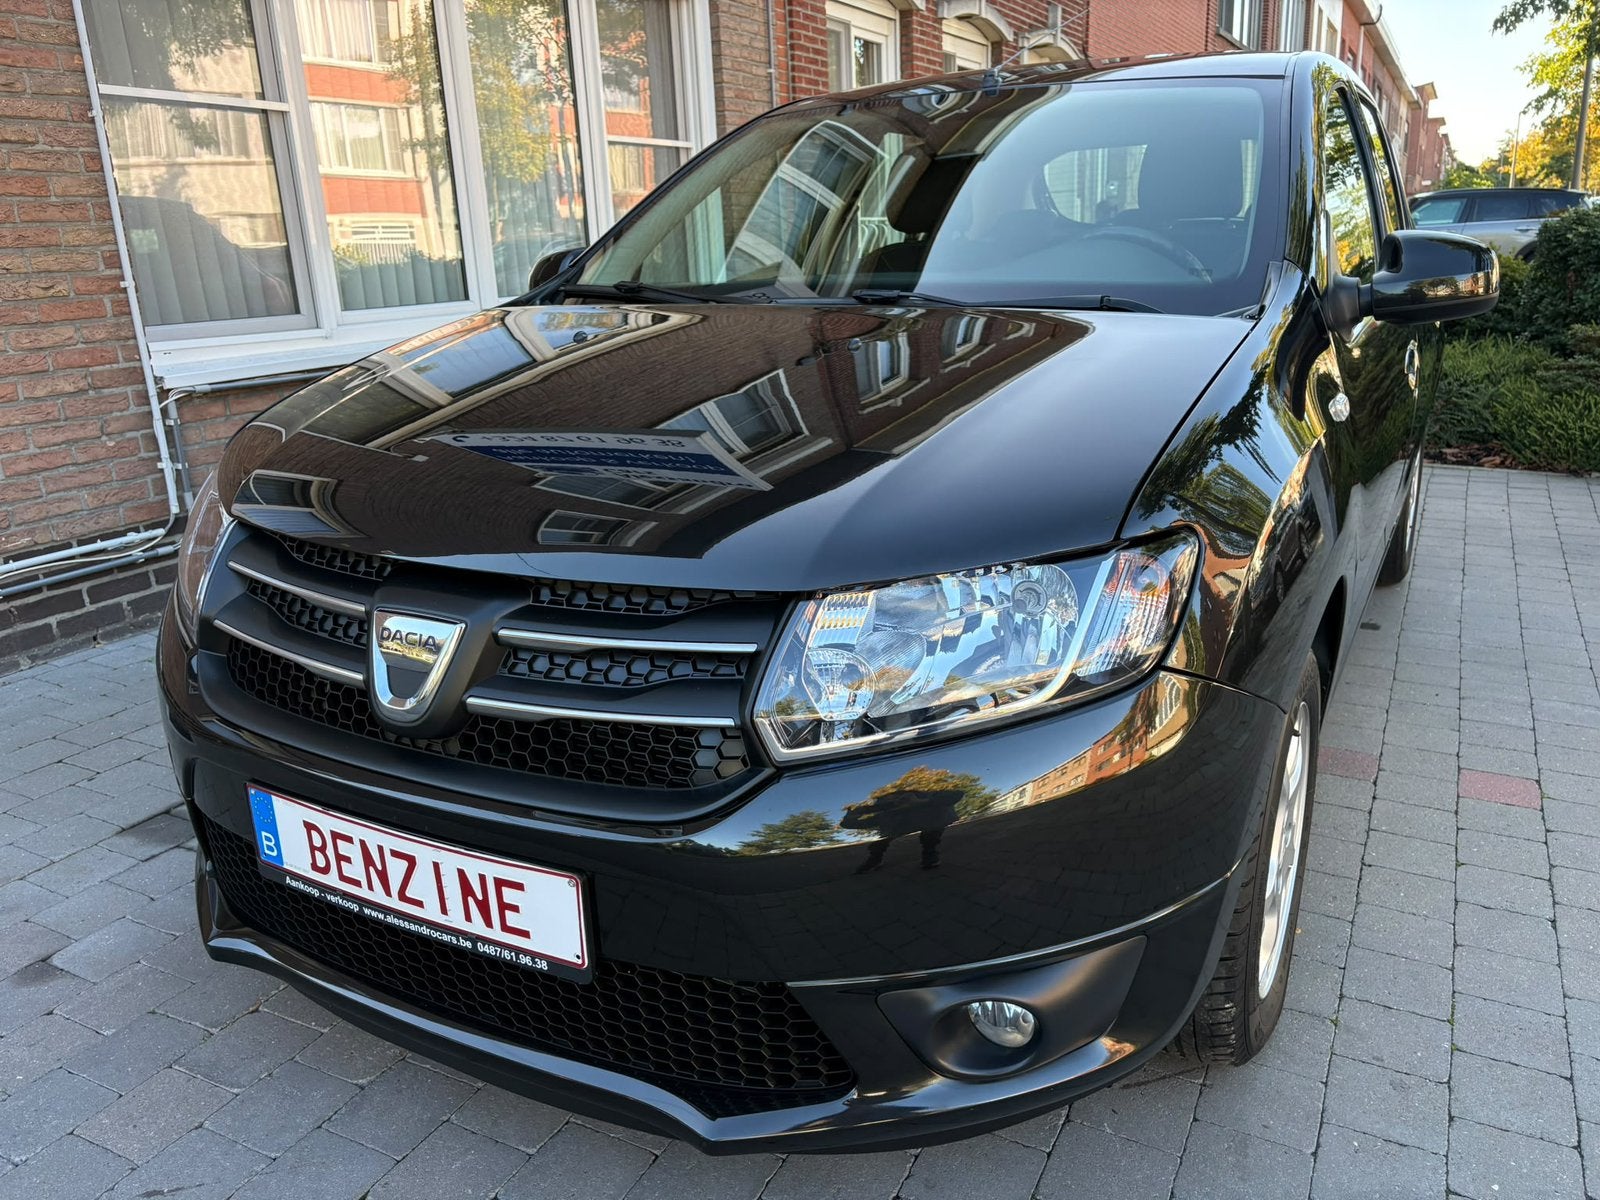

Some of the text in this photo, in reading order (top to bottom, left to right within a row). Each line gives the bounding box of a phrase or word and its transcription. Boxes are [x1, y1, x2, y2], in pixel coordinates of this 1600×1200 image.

[379, 626, 438, 652] DACIA
[261, 831, 278, 857] B
[302, 820, 531, 940] BENZINE
[285, 875, 320, 898] Aankoop
[325, 892, 360, 913] verkoop
[362, 905, 473, 950] www.alessandrocars.be
[477, 942, 549, 971] 0487/61.96.38
